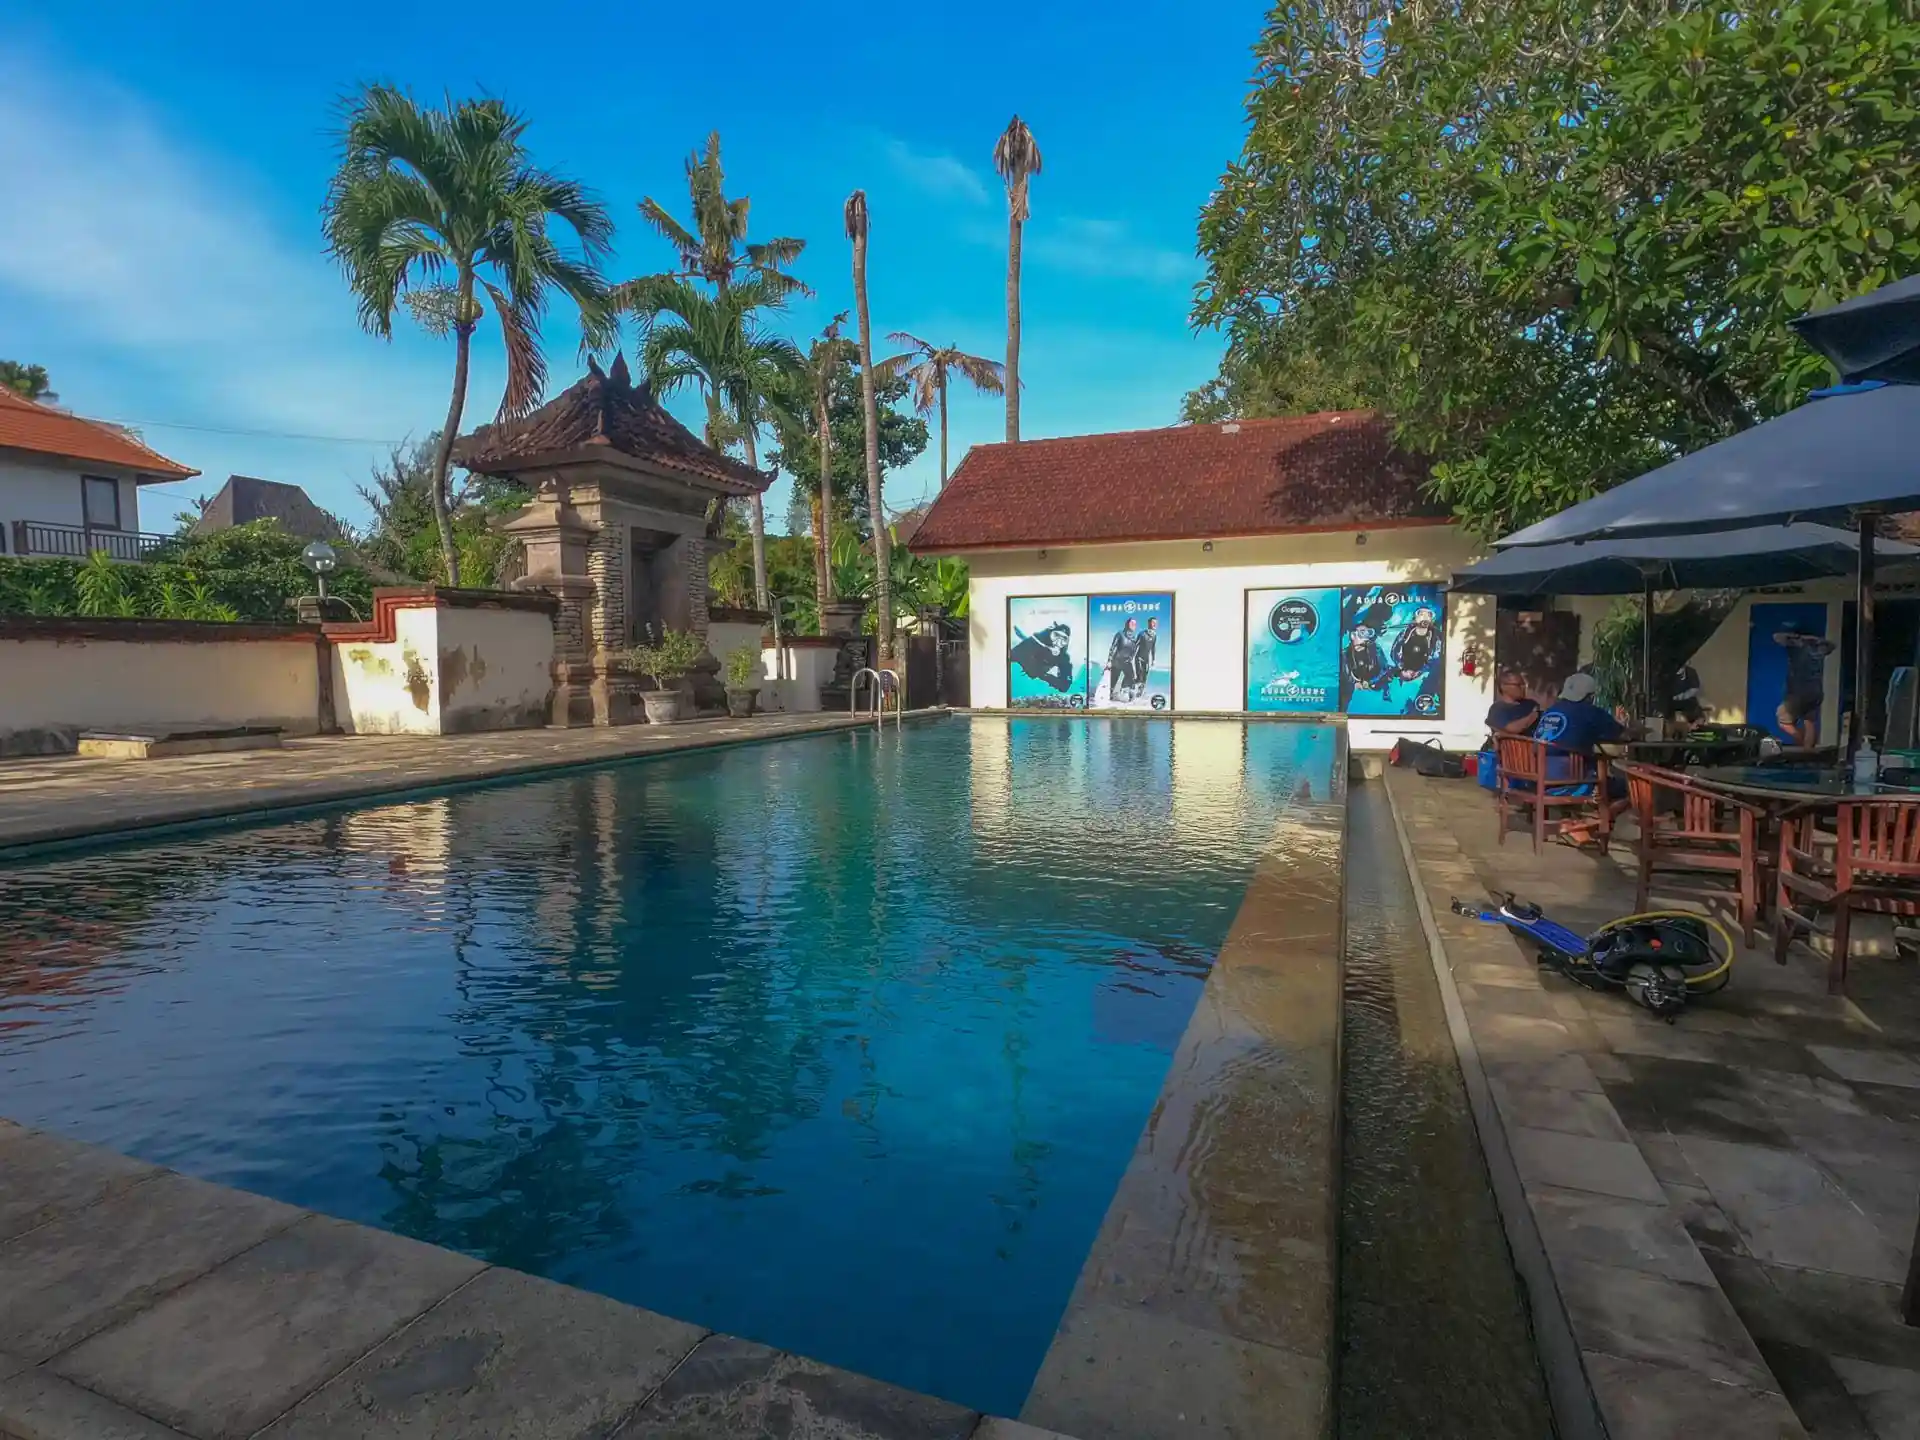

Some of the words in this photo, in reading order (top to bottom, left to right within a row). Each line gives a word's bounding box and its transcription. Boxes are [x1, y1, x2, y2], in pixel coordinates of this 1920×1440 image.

[1356, 596, 1383, 604] AQUA
[1260, 687, 1285, 695] AQUA
[1301, 687, 1326, 695] LUNG
